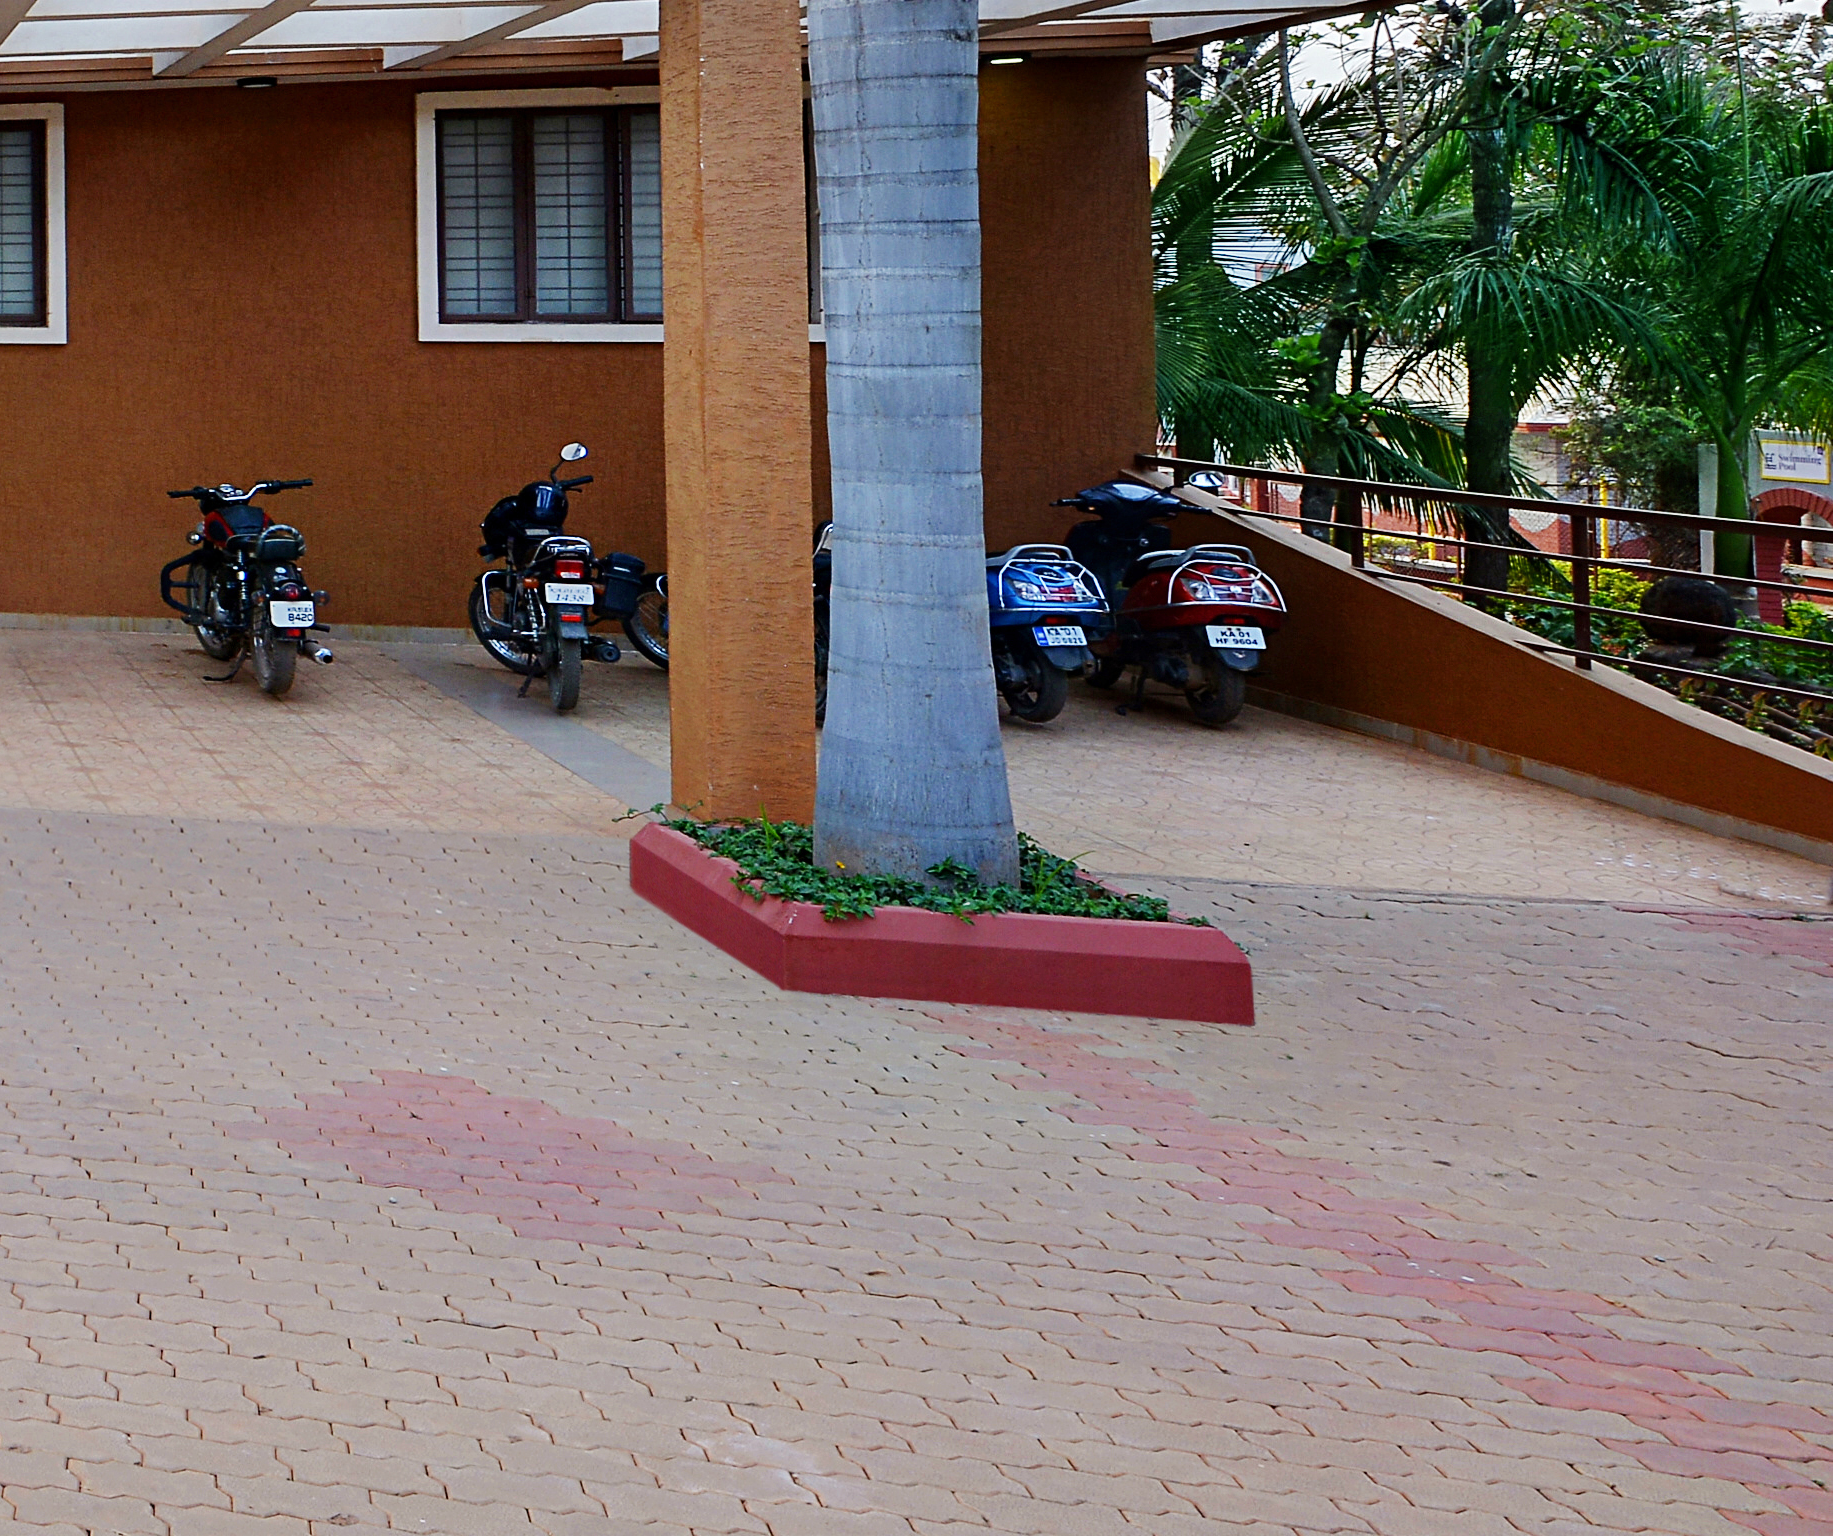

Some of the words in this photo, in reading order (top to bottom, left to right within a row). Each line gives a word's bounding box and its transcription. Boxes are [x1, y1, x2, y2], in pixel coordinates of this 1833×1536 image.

[1778, 453, 1822, 465] Swimming
[1778, 462, 1796, 471] Pool
[1220, 630, 1236, 638] KA
